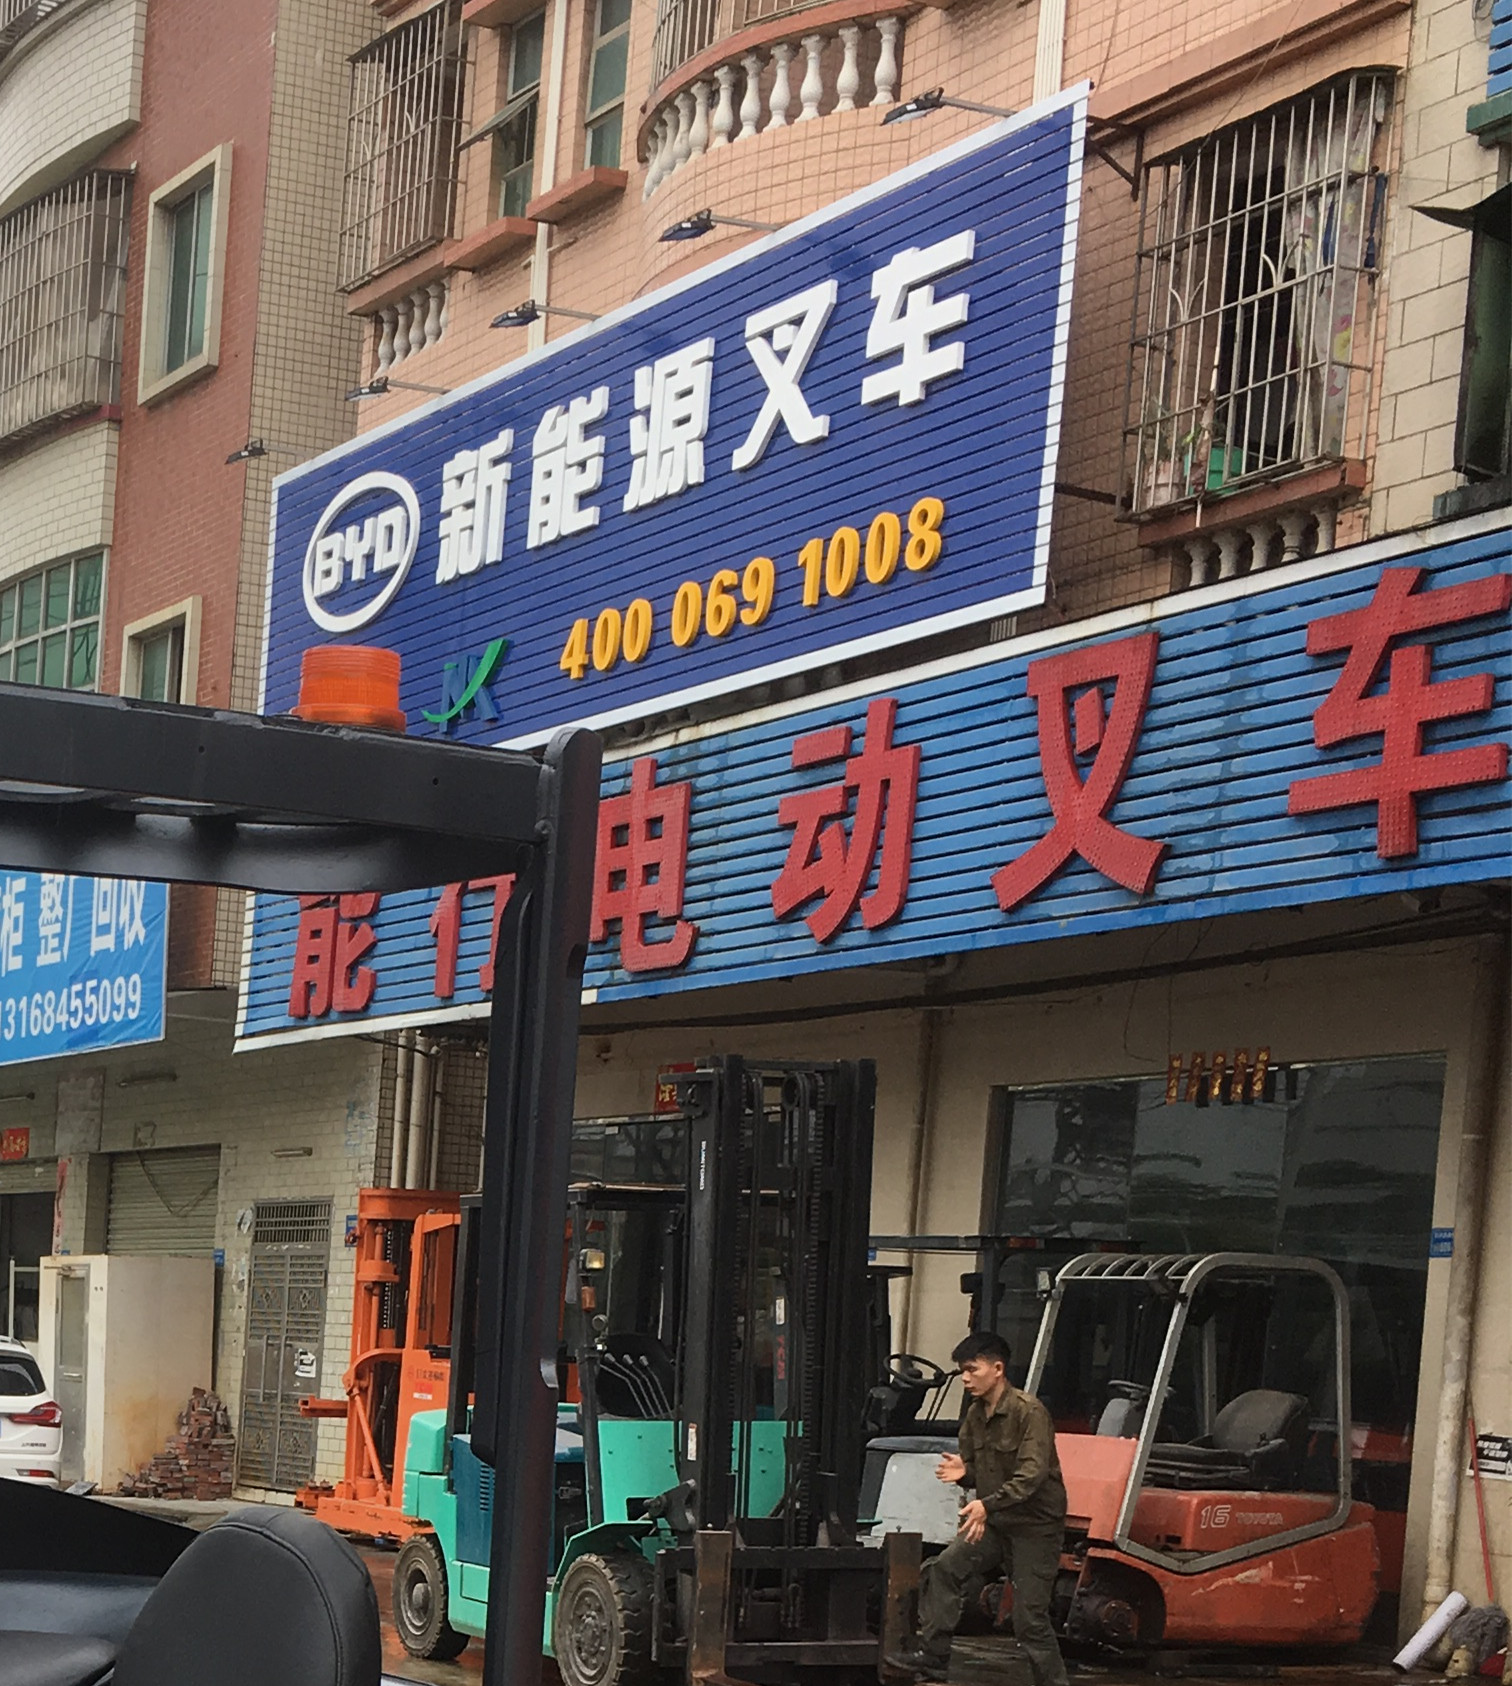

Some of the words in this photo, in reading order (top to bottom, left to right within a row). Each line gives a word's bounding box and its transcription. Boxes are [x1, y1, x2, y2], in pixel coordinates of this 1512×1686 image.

[435, 229, 976, 586] 新能源叉车
[313, 506, 409, 598] BYD
[559, 617, 652, 680] 400
[671, 557, 775, 648] 069
[798, 496, 944, 607] 1008
[1200, 1504, 1232, 1529] 16
